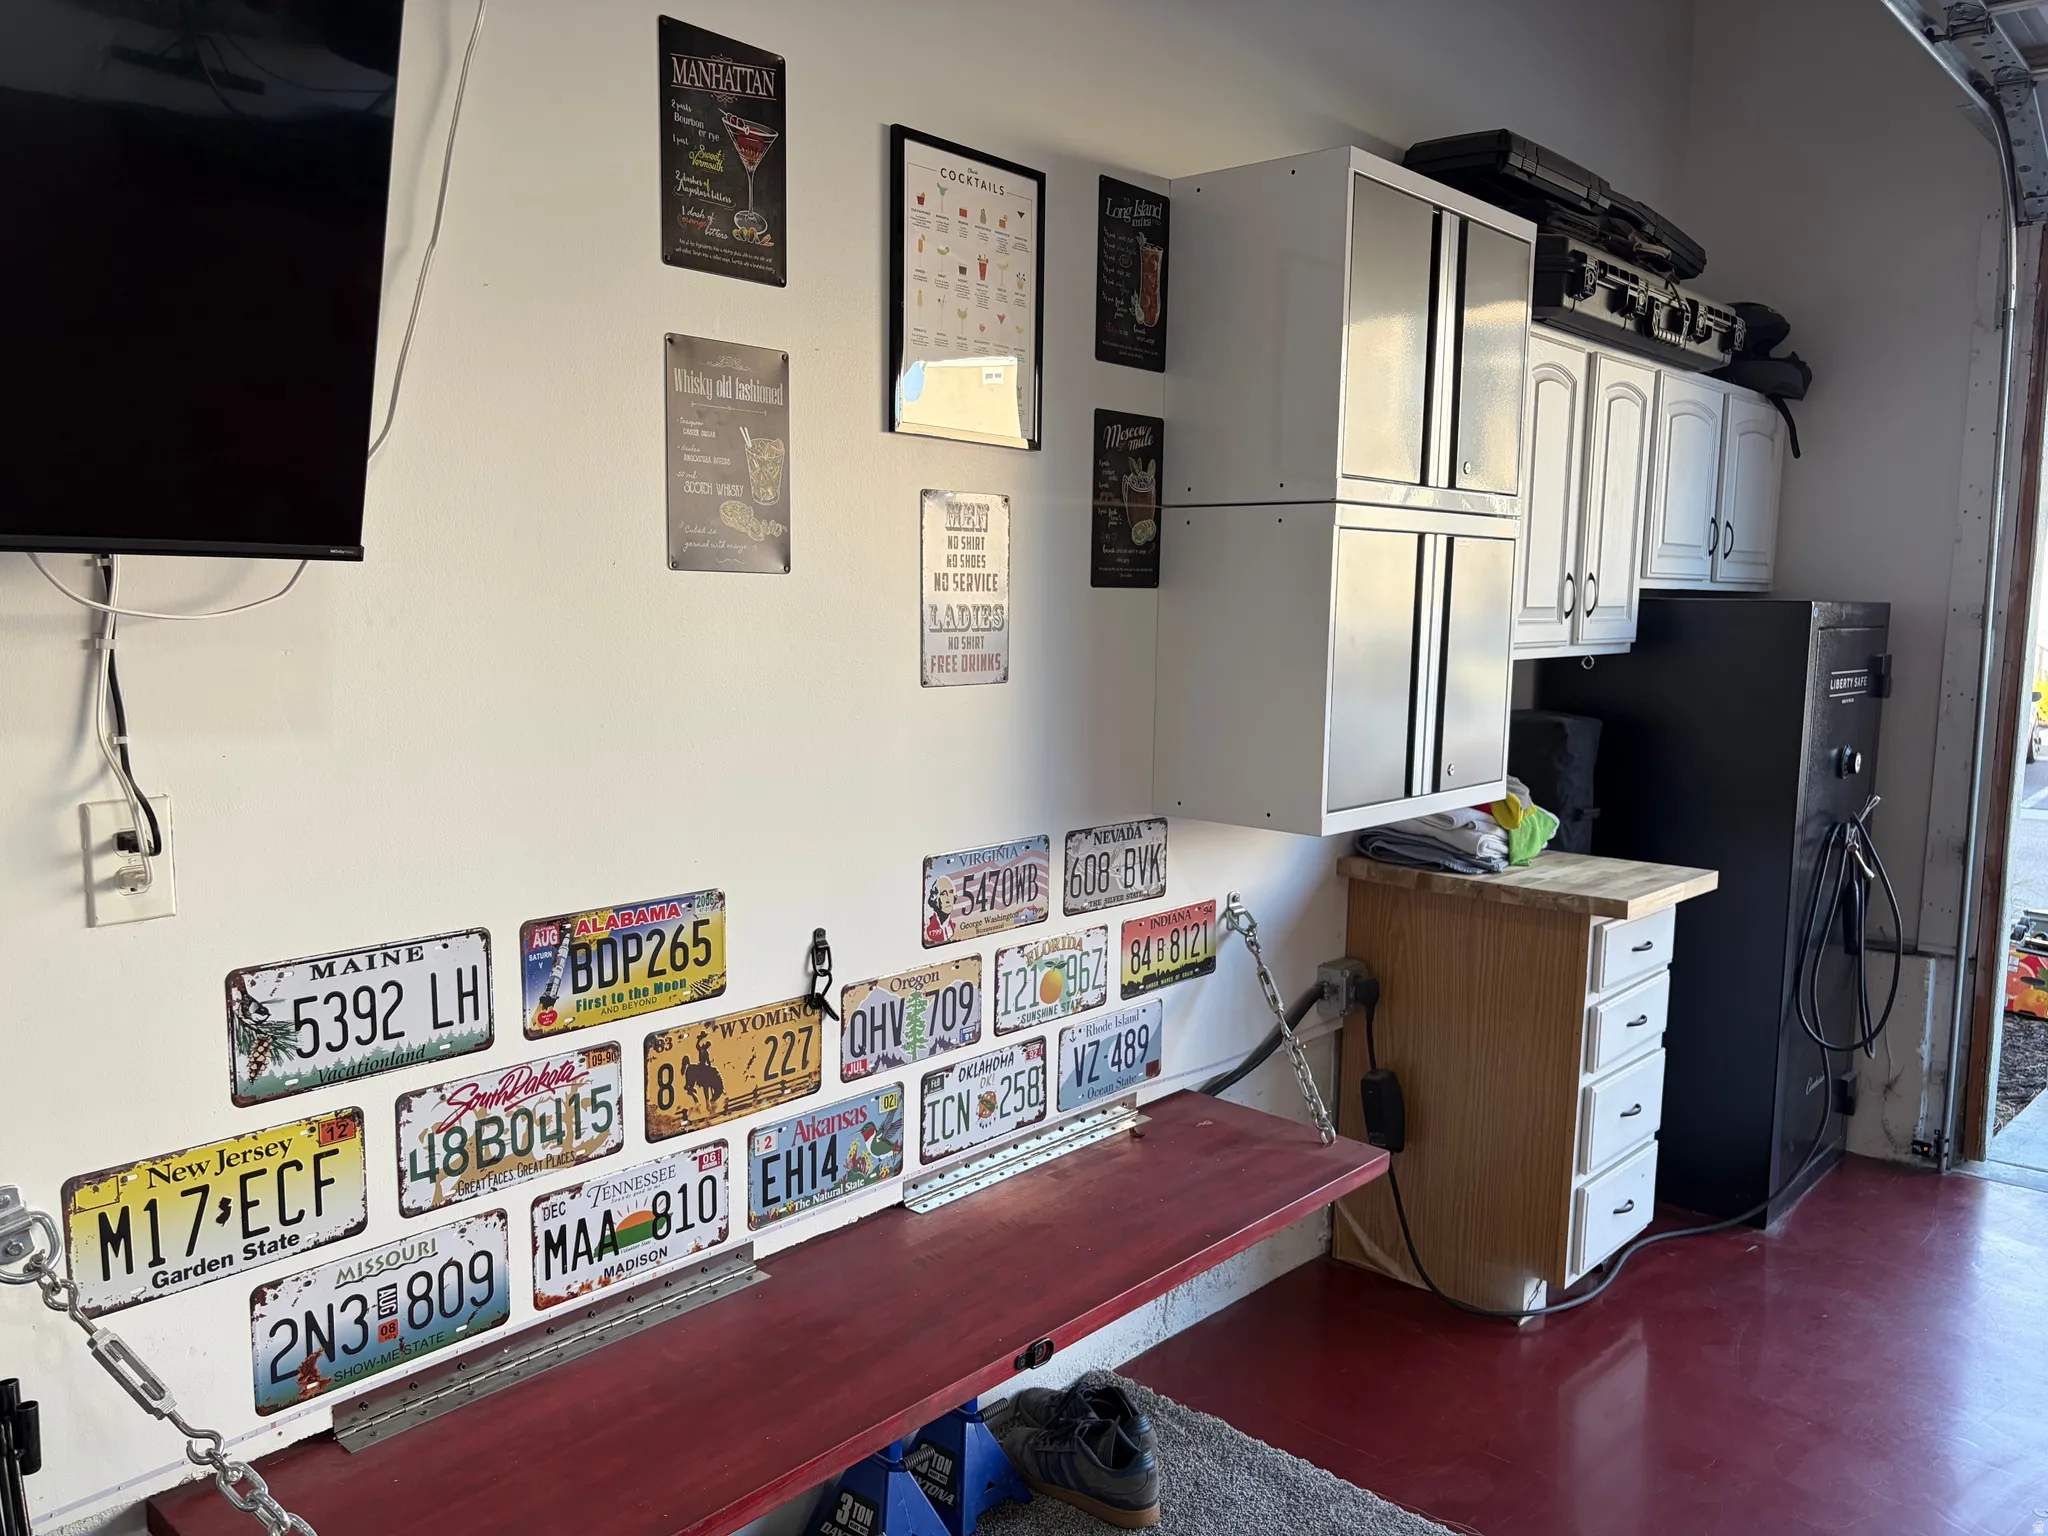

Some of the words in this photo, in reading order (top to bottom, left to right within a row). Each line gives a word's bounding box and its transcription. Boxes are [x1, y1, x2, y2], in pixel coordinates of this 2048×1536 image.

[672, 56, 776, 97] MANHATTAN
[674, 111, 704, 130] Bourbon
[689, 151, 725, 173] Vermouth
[940, 167, 1005, 196] COCKTAILS
[1105, 196, 1133, 223] Long
[1132, 199, 1163, 220] Island
[674, 367, 713, 401] Whisky
[716, 374, 732, 399] old
[735, 376, 784, 406] fashioned
[1103, 423, 1148, 450] Moscow
[1128, 426, 1155, 452] mule
[683, 480, 713, 495] SCOTCH
[716, 483, 744, 497] WHISKY
[944, 501, 990, 532] MEN
[947, 535, 958, 550] NO
[961, 536, 986, 551] SHIRT
[946, 553, 958, 569] NO
[960, 554, 986, 569] SHOES
[933, 572, 949, 592] NO
[952, 572, 998, 592] SERVICE
[928, 603, 1005, 633] LADIES
[948, 636, 959, 650] NO
[961, 635, 985, 650] SHIRT
[930, 655, 958, 674] FREE
[961, 653, 1001, 673] DRINKS
[1830, 677, 1853, 690] LIBERTY
[1854, 676, 1868, 687] SAFE
[1093, 825, 1143, 846] NEVADA
[960, 845, 1019, 867] VIRGINIA
[1070, 851, 1110, 898] 608
[1124, 842, 1162, 889] BVK
[575, 901, 681, 938] ALABAMA
[960, 920, 982, 931] George
[983, 911, 1018, 924] Washington
[1150, 909, 1192, 930] INDIANA
[533, 929, 558, 949] AUG
[1025, 936, 1084, 967] FLORIDA
[1131, 935, 1151, 975] 84
[1157, 937, 1164, 963] B
[1170, 919, 1208, 964] 8121
[309, 945, 424, 981] MAINE
[528, 950, 553, 962] SATURN
[538, 962, 544, 970] V
[568, 919, 712, 995] BDP265
[575, 997, 606, 1013] First
[611, 991, 625, 1004] to
[629, 986, 649, 1001] the
[654, 978, 687, 995] Moon
[890, 970, 940, 993] Oregon
[293, 979, 406, 1060] 5392
[430, 964, 480, 1030] LH
[601, 1004, 619, 1016] AND
[622, 997, 658, 1012] BEYOND
[850, 998, 905, 1059] QHV
[925, 981, 974, 1037] 709
[1021, 1004, 1059, 1024] SUNSHINE
[1086, 1018, 1113, 1038] Rhode
[1115, 1008, 1140, 1028] Island
[317, 1044, 427, 1085] Vacationland
[764, 1025, 813, 1082] 227
[847, 1062, 865, 1075] JUL
[958, 1051, 1014, 1082] OKLAHOMA
[657, 1062, 675, 1111] 8
[980, 1073, 995, 1089] OK!
[1087, 1083, 1115, 1100] Ocean
[1116, 1074, 1137, 1090] State
[436, 1082, 513, 1134] South
[499, 1060, 589, 1103] Dakota
[884, 1094, 894, 1109] 02
[927, 1088, 970, 1147] ICN
[1000, 1065, 1041, 1119] 258
[327, 1124, 348, 1140] 12
[791, 1104, 868, 1147] Arkansas
[765, 1135, 772, 1149] 2
[147, 1160, 212, 1190] New
[214, 1138, 293, 1176] Jersey
[703, 1151, 717, 1164] 06
[762, 1133, 839, 1208] EH14
[457, 1176, 488, 1197] GREAT
[517, 1160, 544, 1179] GREAT
[587, 1164, 676, 1209] TENNESSEE
[794, 1198, 811, 1211] The
[812, 1184, 844, 1203] Natural
[845, 1178, 865, 1191] State
[98, 1183, 210, 1282] M17
[239, 1148, 340, 1240] ECF
[543, 1201, 566, 1222] DEC
[544, 1209, 619, 1281] MAA
[652, 1174, 717, 1241] 810
[151, 1254, 234, 1289] Garden
[242, 1233, 300, 1261] State
[335, 1237, 438, 1285] MISSOURI
[604, 1245, 668, 1279] MADISON
[269, 1293, 369, 1384] 2N3
[406, 1249, 495, 1330] 809
[379, 1288, 397, 1316] AUG
[380, 1322, 396, 1336] 08
[334, 1349, 400, 1383] SHOW-ME
[404, 1331, 445, 1353] STATE
[931, 1452, 953, 1476] TON
[835, 1492, 854, 1525] 3
[852, 1502, 875, 1527] TON
